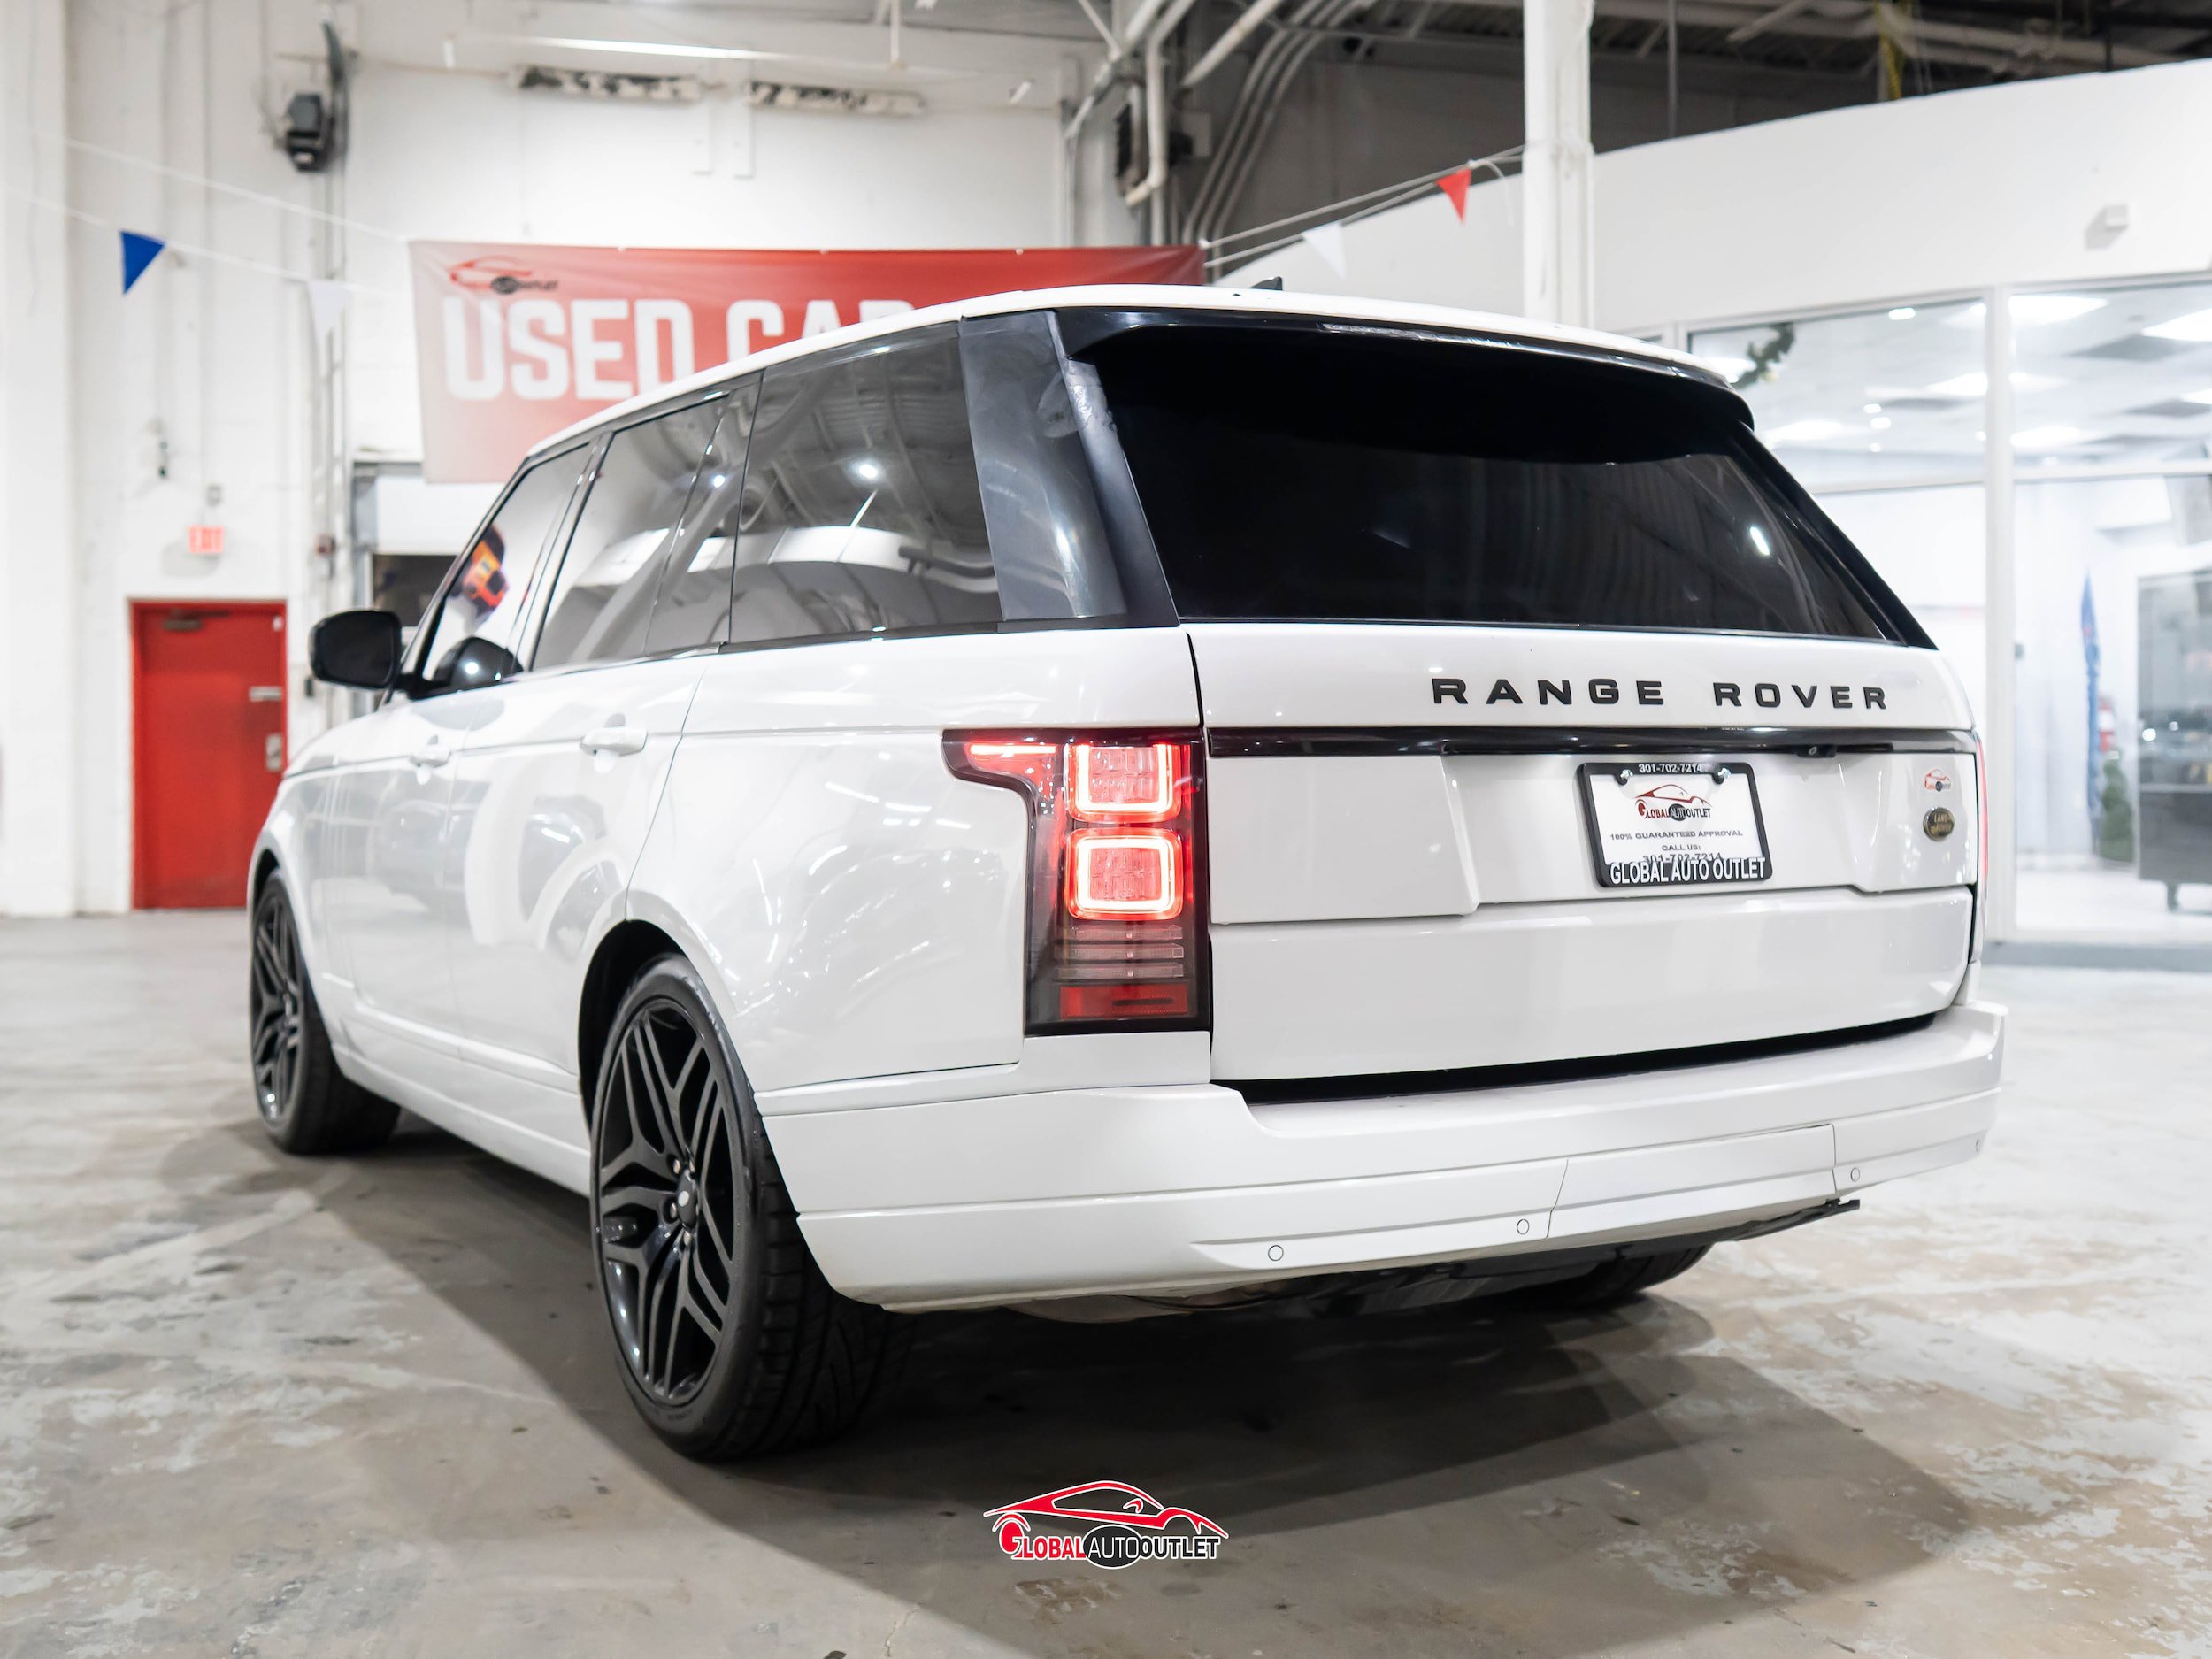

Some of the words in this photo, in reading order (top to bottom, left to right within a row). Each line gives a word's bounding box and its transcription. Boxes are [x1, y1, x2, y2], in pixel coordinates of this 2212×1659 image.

[445, 296, 695, 400] USED
[1432, 678, 1664, 705] RANGE
[1713, 682, 1886, 709] ROVER
[1638, 763, 1703, 773] 301-702-7214
[1635, 830, 1696, 839] GUARANTEED
[1609, 862, 1669, 885] GLOBAL
[1671, 859, 1709, 882] AUTO
[1713, 856, 1766, 880] OUTLET
